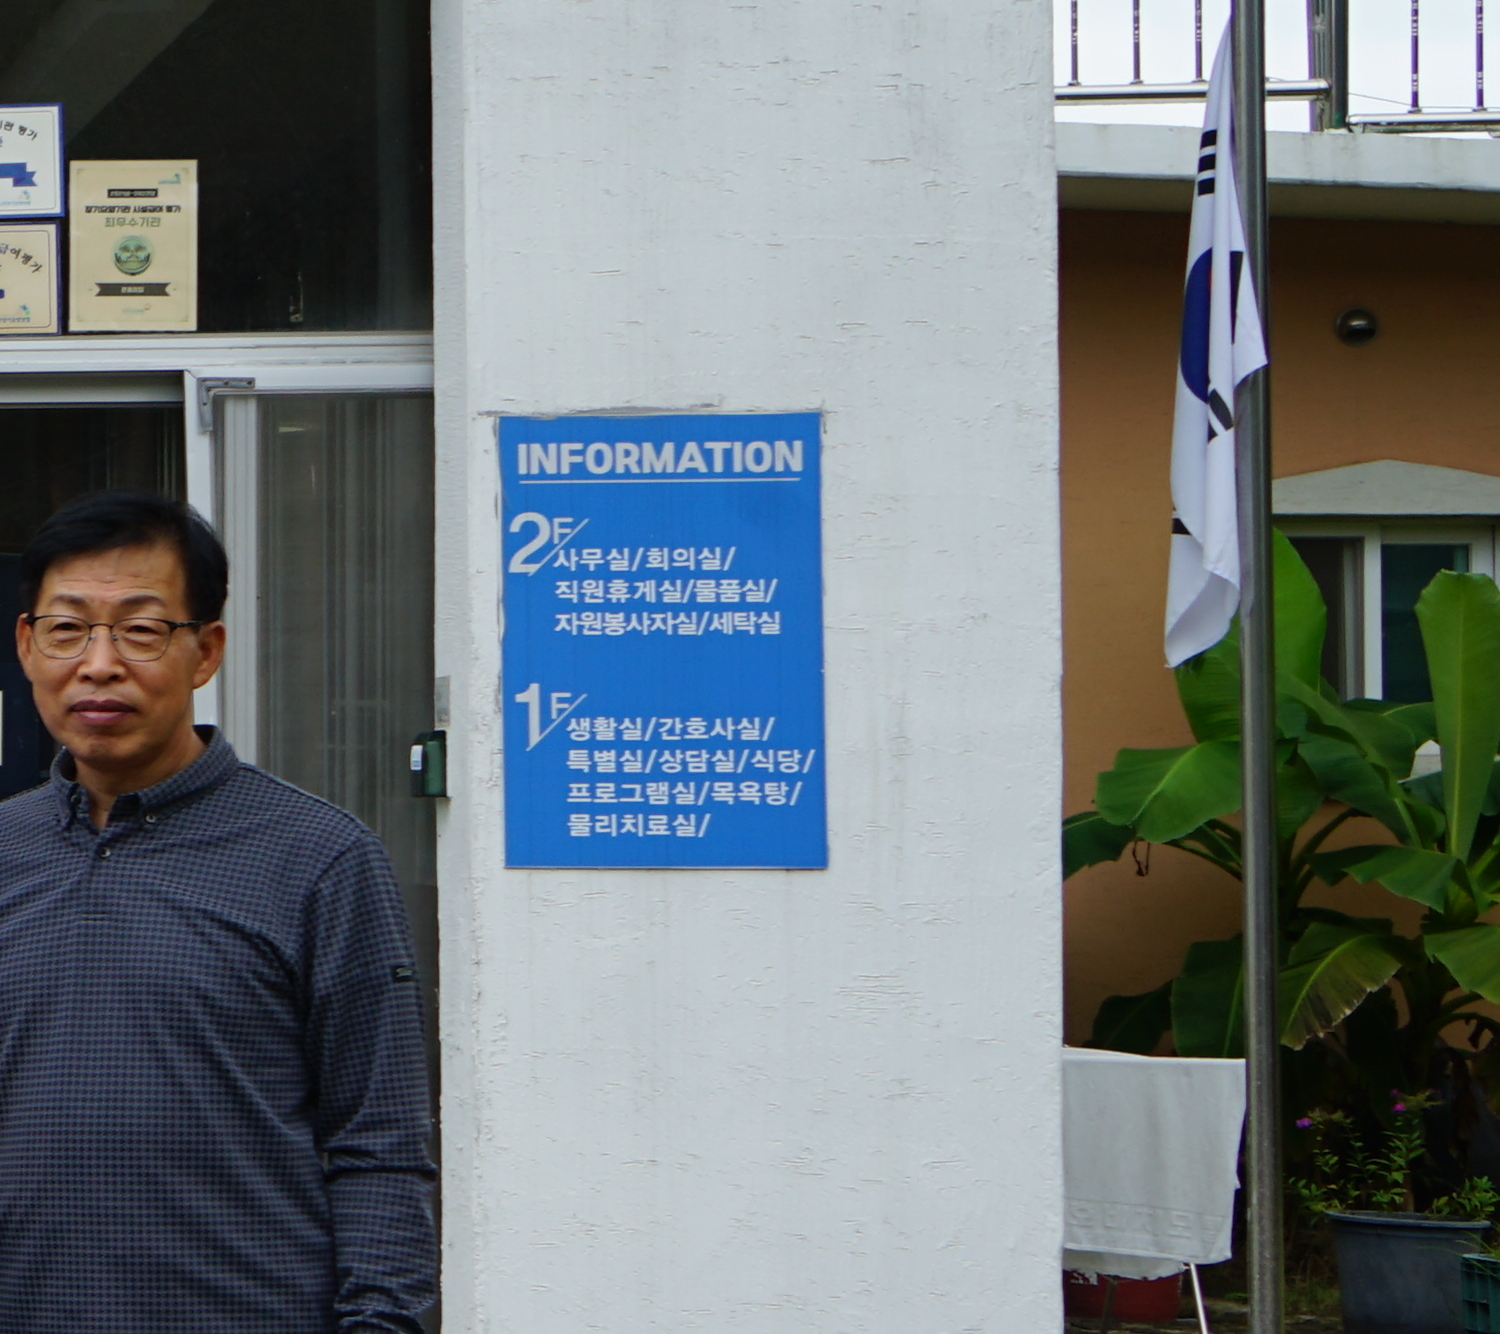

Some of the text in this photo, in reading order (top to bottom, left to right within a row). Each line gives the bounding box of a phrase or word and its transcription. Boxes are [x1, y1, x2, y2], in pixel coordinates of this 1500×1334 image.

[18, 124, 38, 141] 평가
[105, 217, 161, 228] 최우수기관
[517, 440, 804, 475] INFORMATION
[554, 578, 778, 604] 직원휴게실/물품실/
[554, 611, 781, 636] 자원봉사자실/세탁실
[566, 717, 776, 742] 생활실/간호사실/
[566, 749, 816, 774] 특별실/상담실/식당/
[566, 781, 804, 806] 프로그램실/목욕탕/
[566, 813, 712, 838] 물리치료실/
